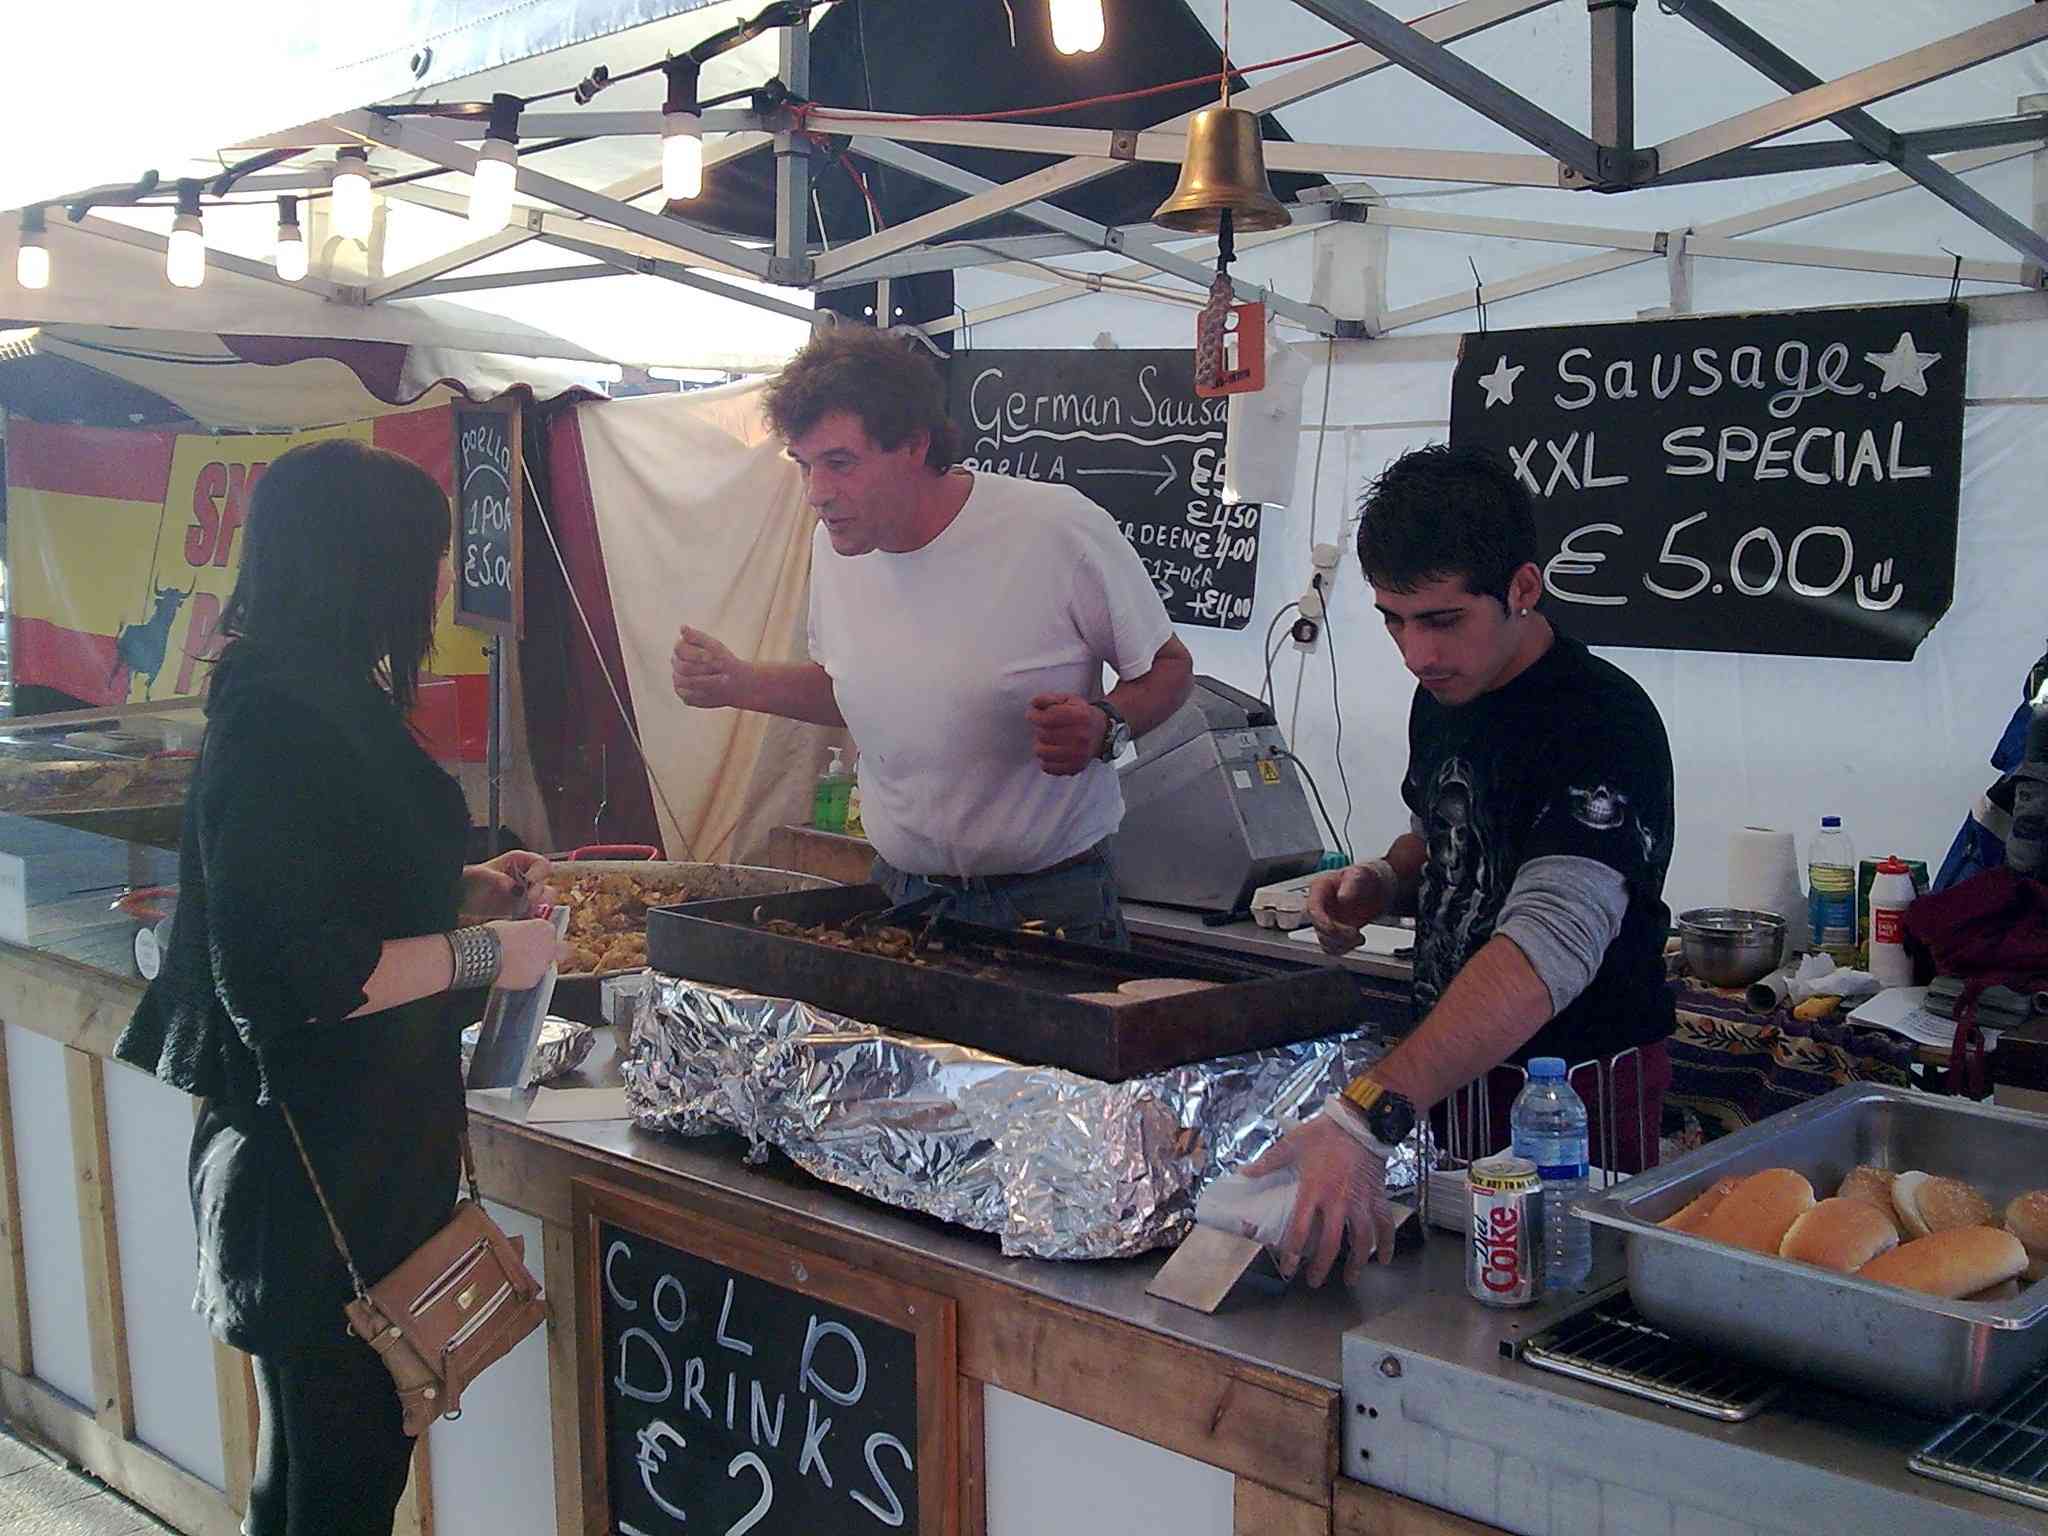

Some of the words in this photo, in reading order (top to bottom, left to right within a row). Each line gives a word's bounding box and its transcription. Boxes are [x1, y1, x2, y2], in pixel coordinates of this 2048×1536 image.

[970, 368, 1120, 452] German
[1508, 431, 1629, 497] XXL
[1662, 420, 1931, 485] SPECIAL
[1472, 1214, 1489, 1265] Diet
[1481, 1206, 1519, 1293] Coke
[606, 1241, 866, 1406] COLD
[615, 1327, 914, 1527] DRINKS
[726, 1451, 774, 1536] 2
